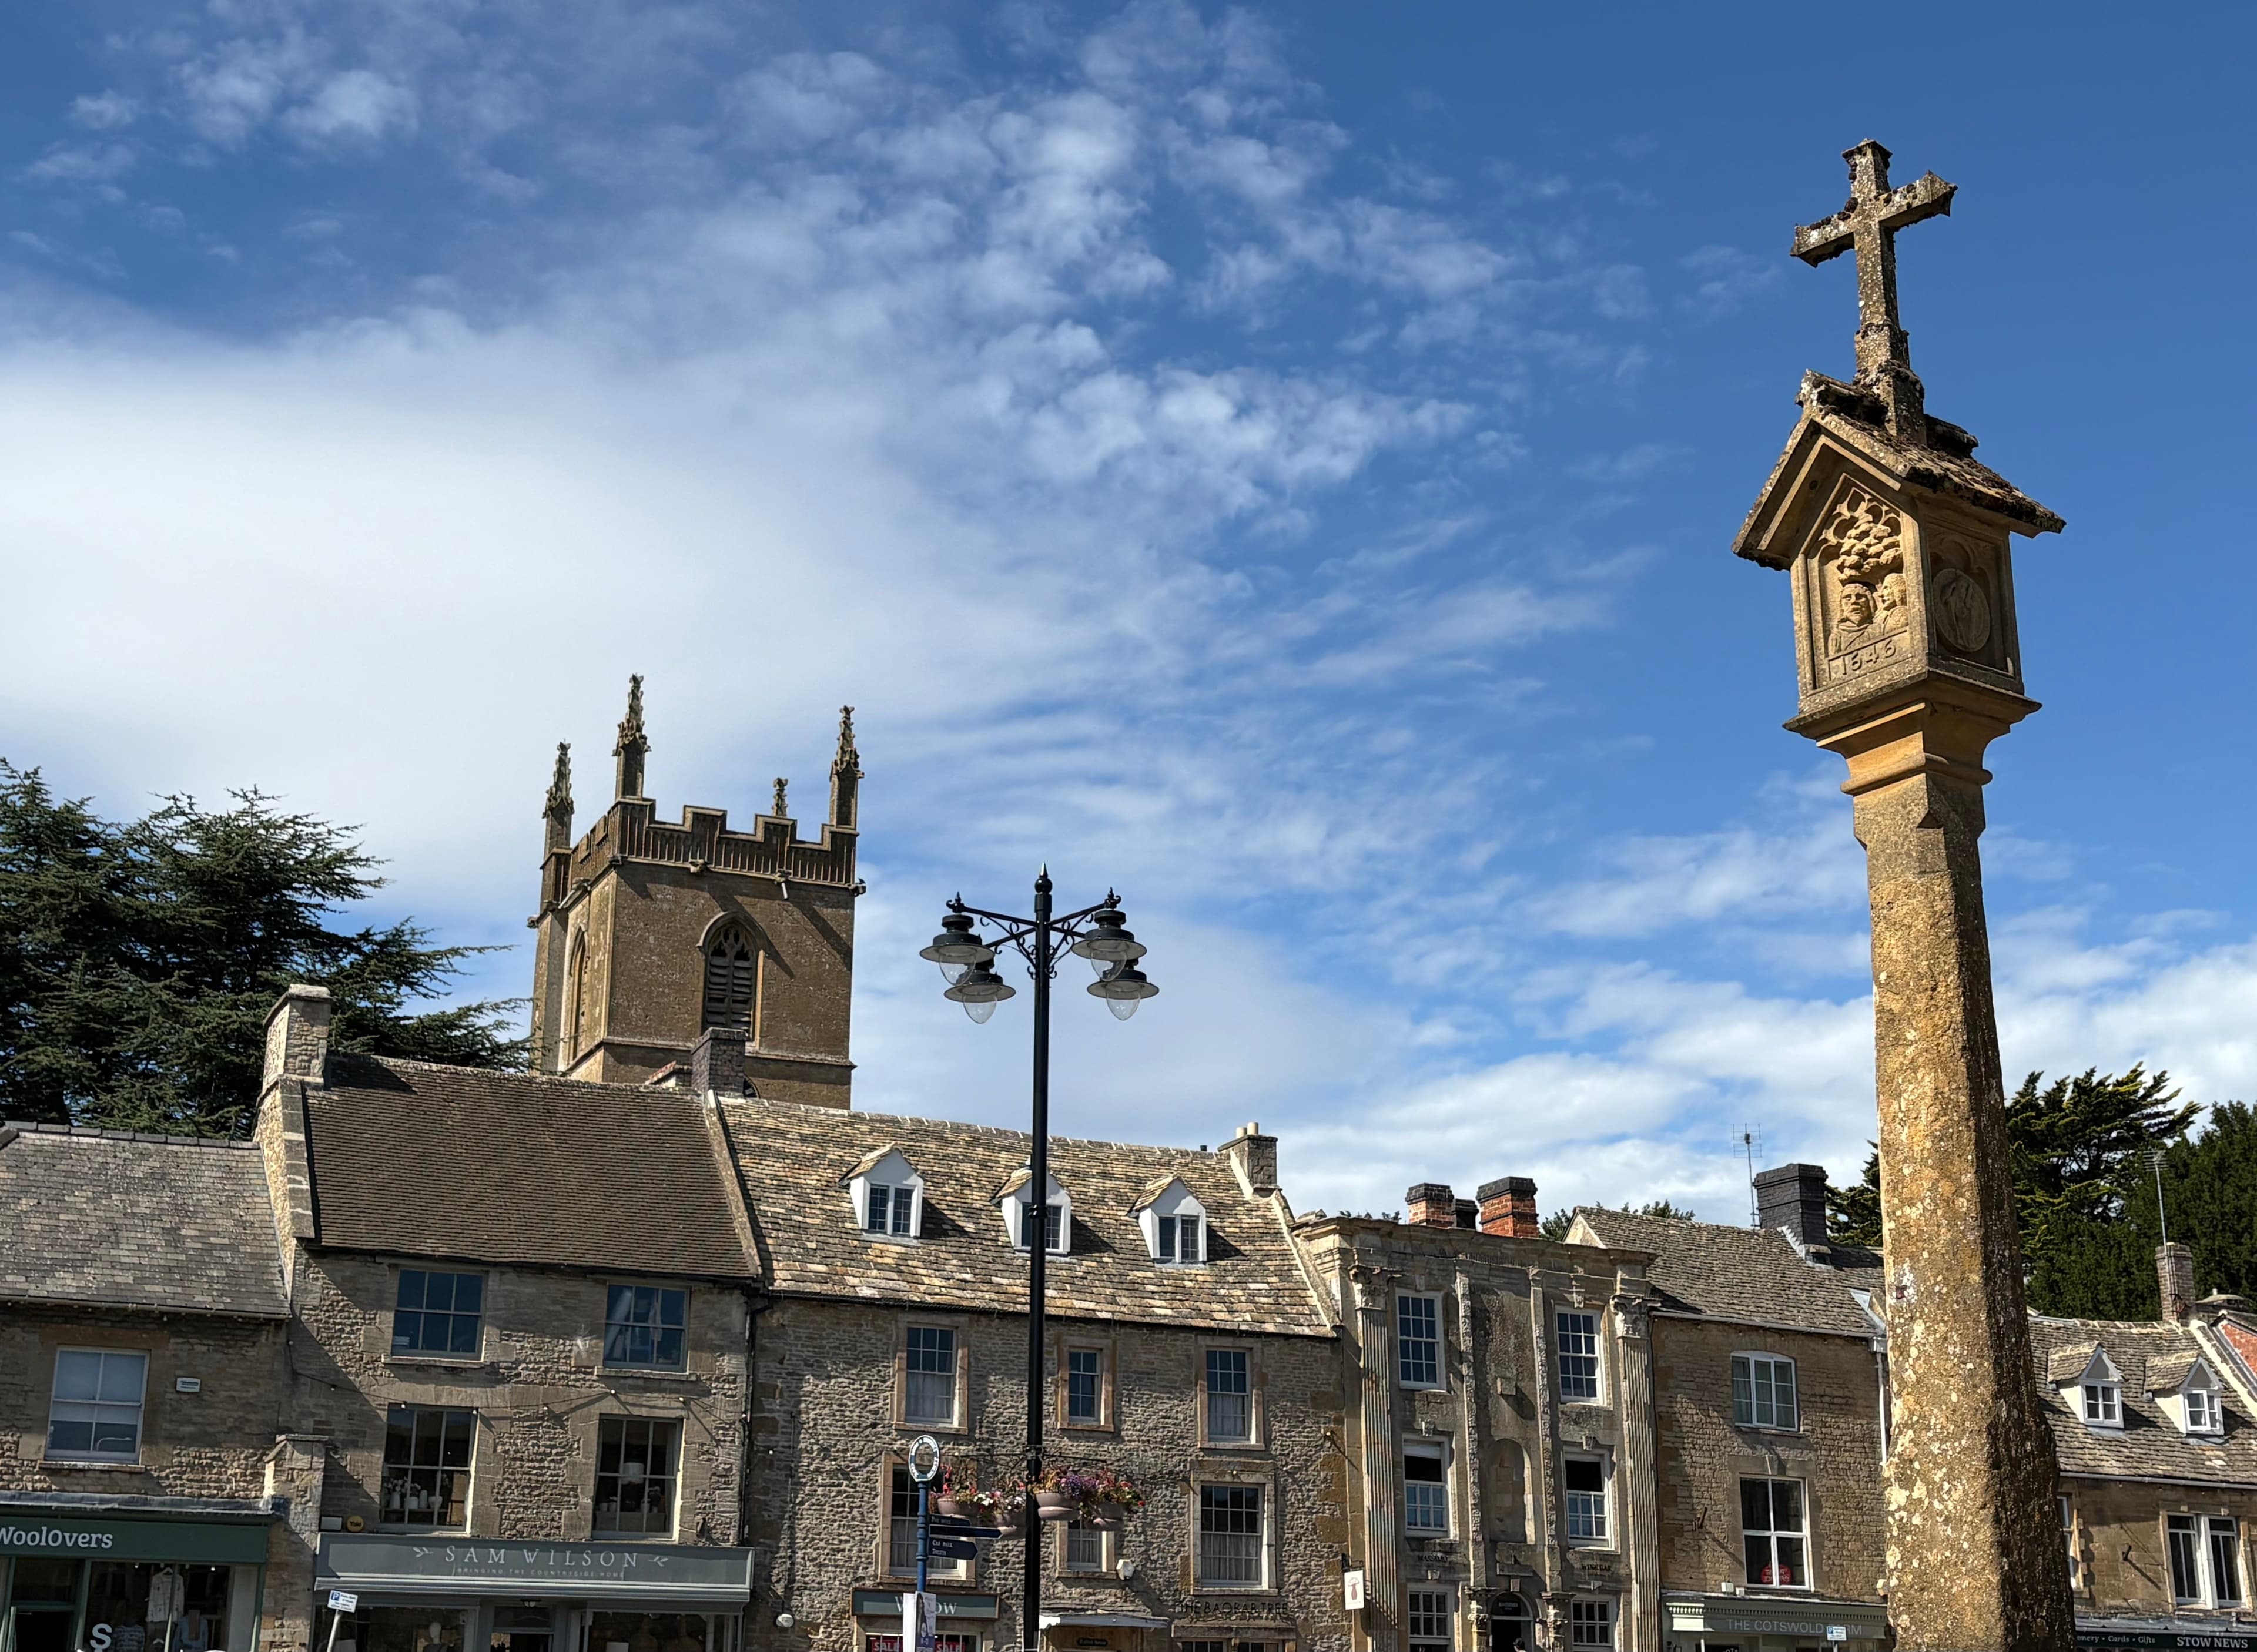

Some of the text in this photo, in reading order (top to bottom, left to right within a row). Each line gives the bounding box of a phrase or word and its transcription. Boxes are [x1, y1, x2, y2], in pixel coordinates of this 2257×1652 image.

[1842, 638, 1897, 675] 1646
[0, 1526, 113, 1549] WoolOvers
[445, 1545, 638, 1568] SAM WILSON
[1726, 1619, 1750, 1630] THE
[1754, 1620, 1824, 1634] COTSWOLD
[2138, 1636, 2156, 1644] Gifts
[2176, 1636, 2248, 1648] STOW NEWS
